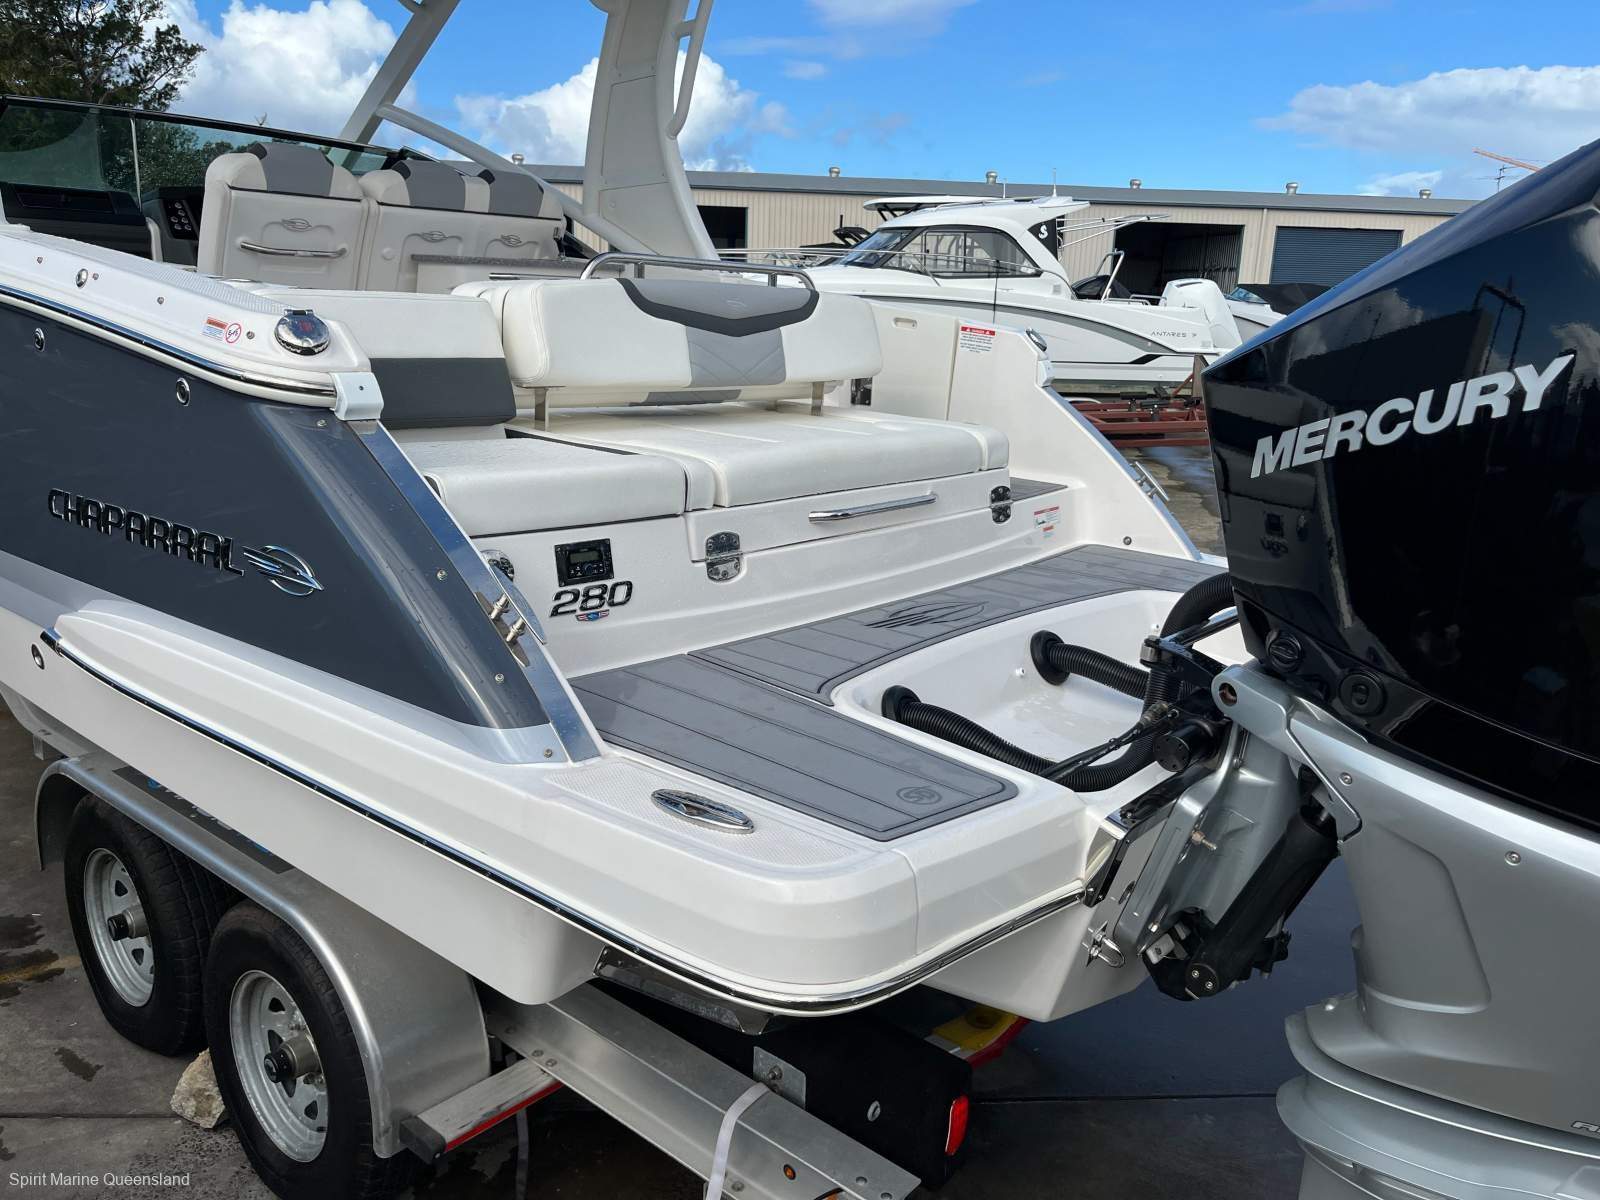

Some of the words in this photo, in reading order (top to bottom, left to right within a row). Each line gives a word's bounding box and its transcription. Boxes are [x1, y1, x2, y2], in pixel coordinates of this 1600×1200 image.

[1250, 354, 1574, 479] MERCURY
[48, 488, 245, 577] CHAPARRAL
[550, 580, 633, 618] 280
